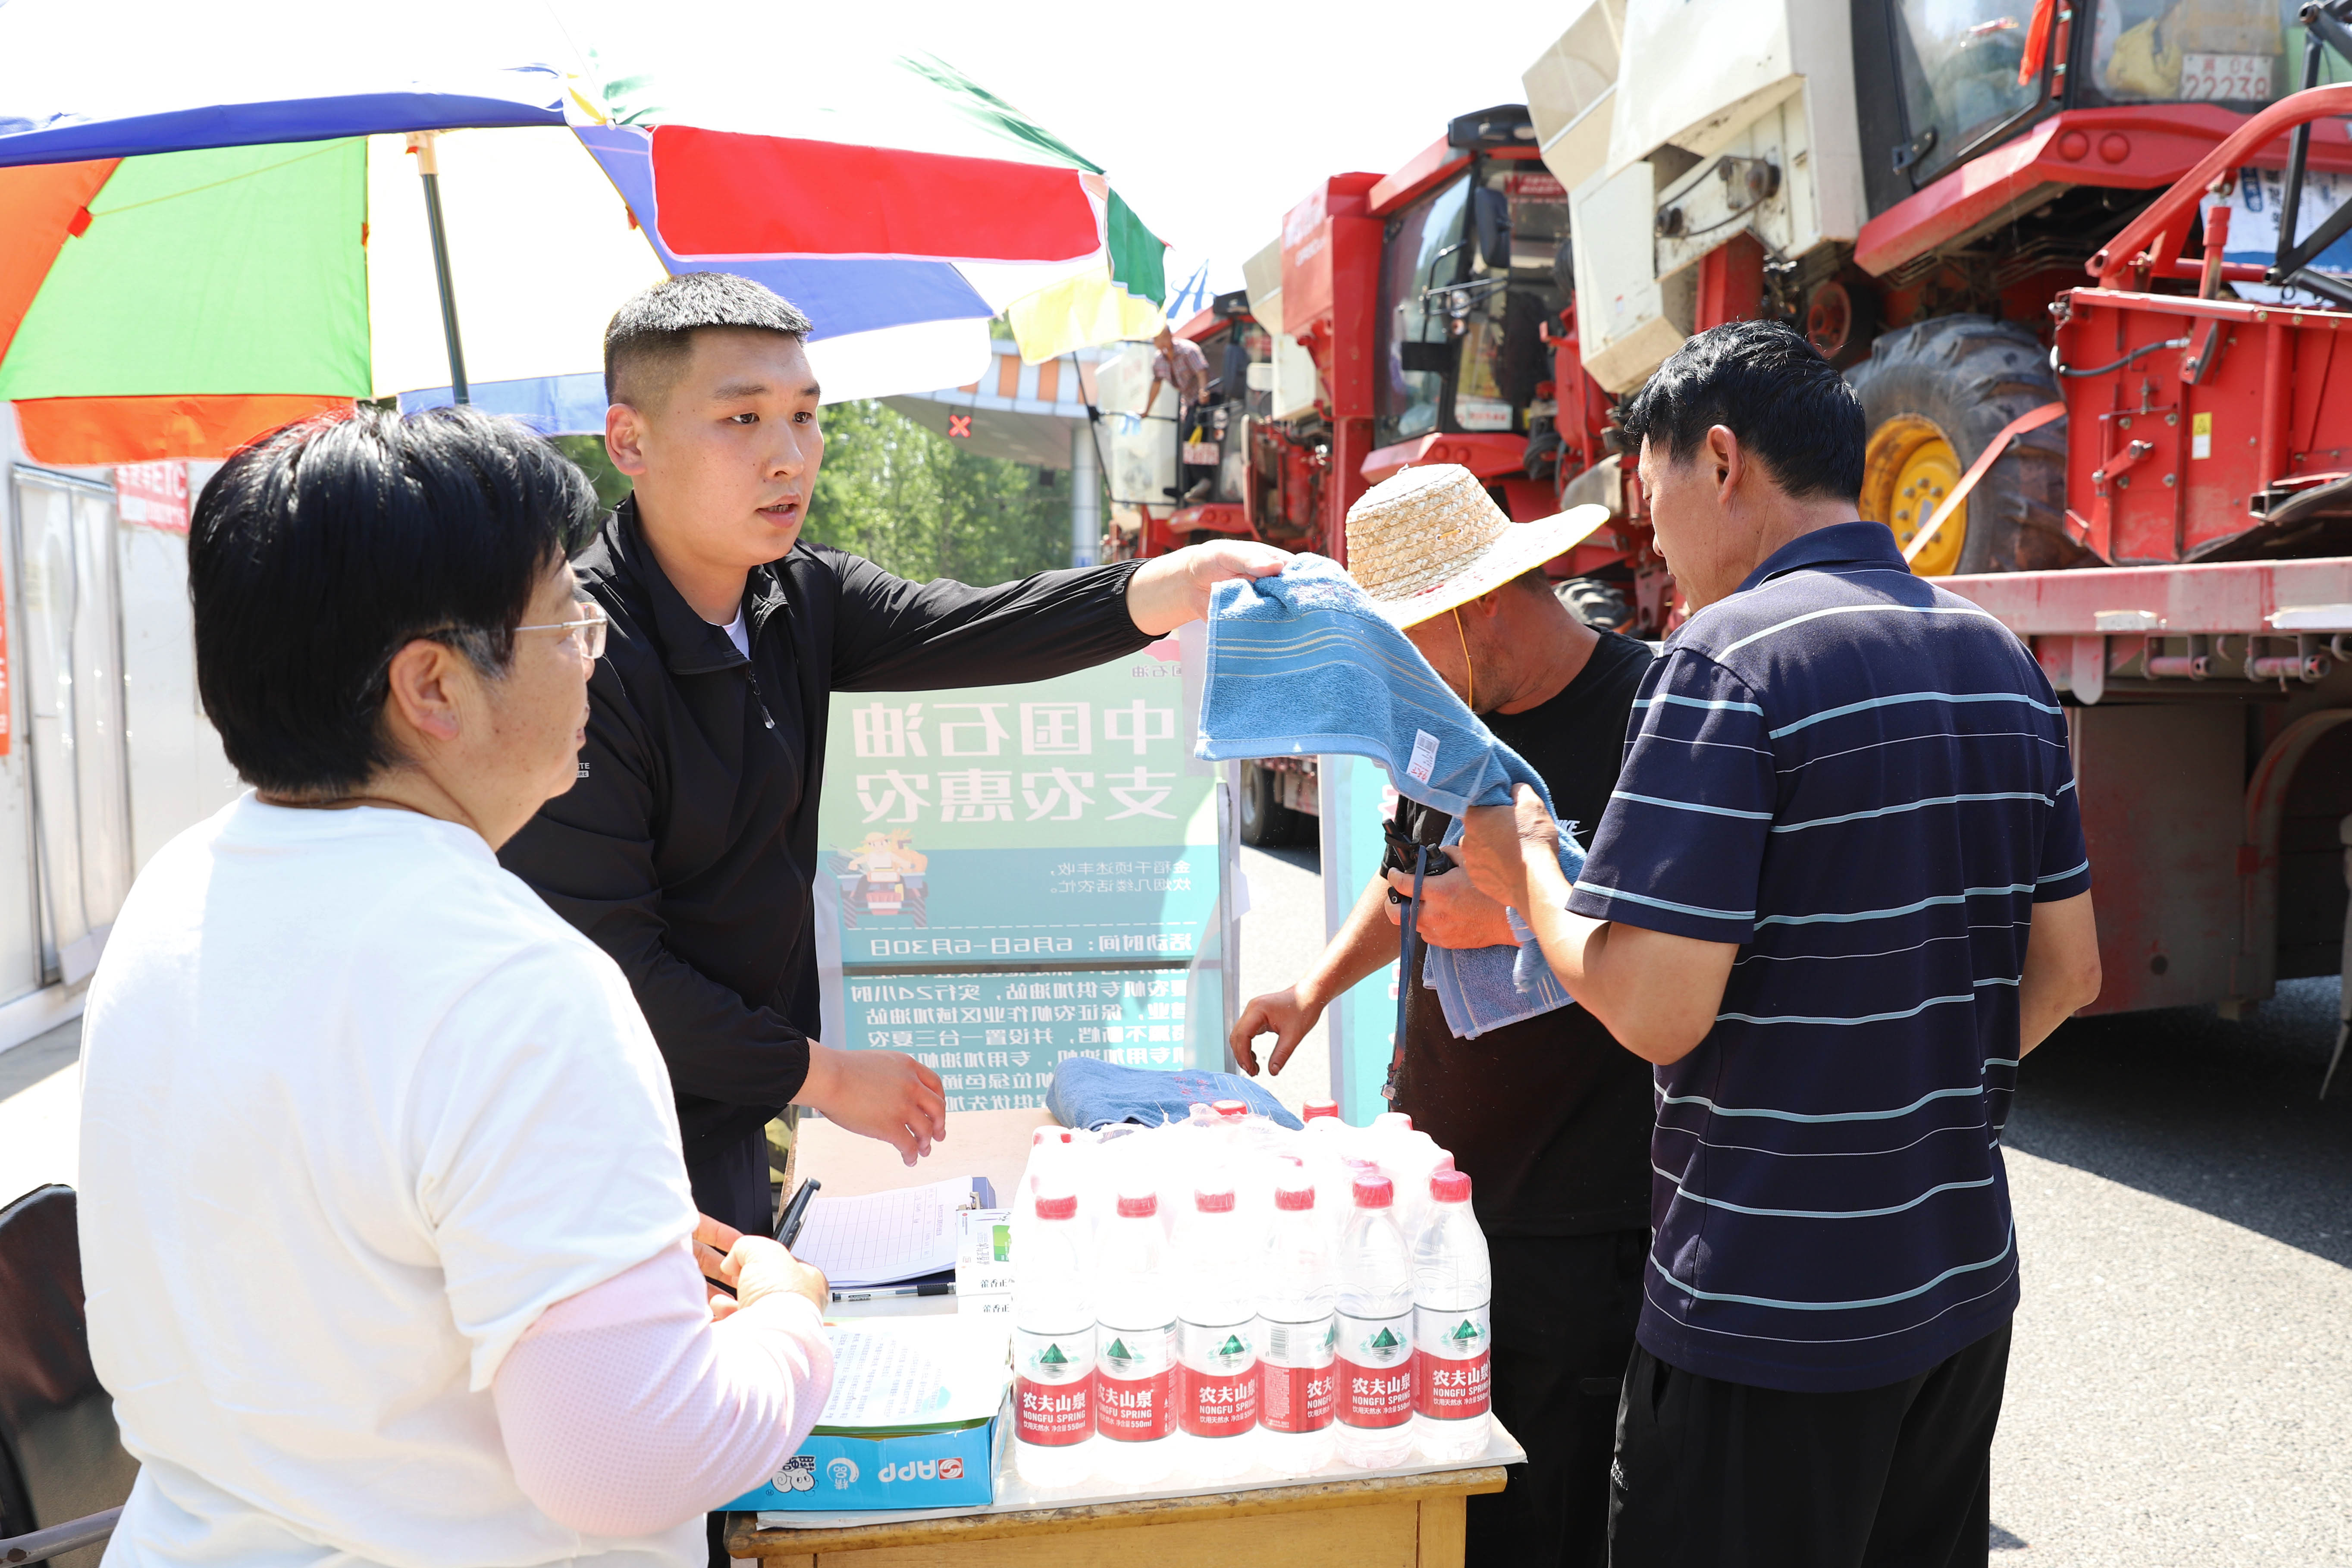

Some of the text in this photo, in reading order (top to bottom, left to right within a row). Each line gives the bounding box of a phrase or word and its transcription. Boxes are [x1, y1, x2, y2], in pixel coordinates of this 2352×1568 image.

[1556, 819, 1581, 834] IKE
[1433, 1363, 1488, 1387] 农夫山泉
[1306, 1376, 1334, 1399] 农夫
[1352, 1373, 1411, 1396] 农夫山泉
[1433, 1382, 1489, 1397] NONGFU SPRING
[1023, 1391, 1086, 1413] 农夫山泉
[1307, 1396, 1332, 1409] NONGFU
[1352, 1389, 1410, 1406] NONGFU SPRING
[1121, 1409, 1152, 1419] SPRING
[1199, 1402, 1233, 1415] NONGFU
[1352, 1406, 1381, 1415] 饮用天然水
[1023, 1410, 1086, 1423] NONGFU SPRING
[1023, 1420, 1086, 1432] 饮用天然水 净含量550ml
[878, 1459, 936, 1483] APP
